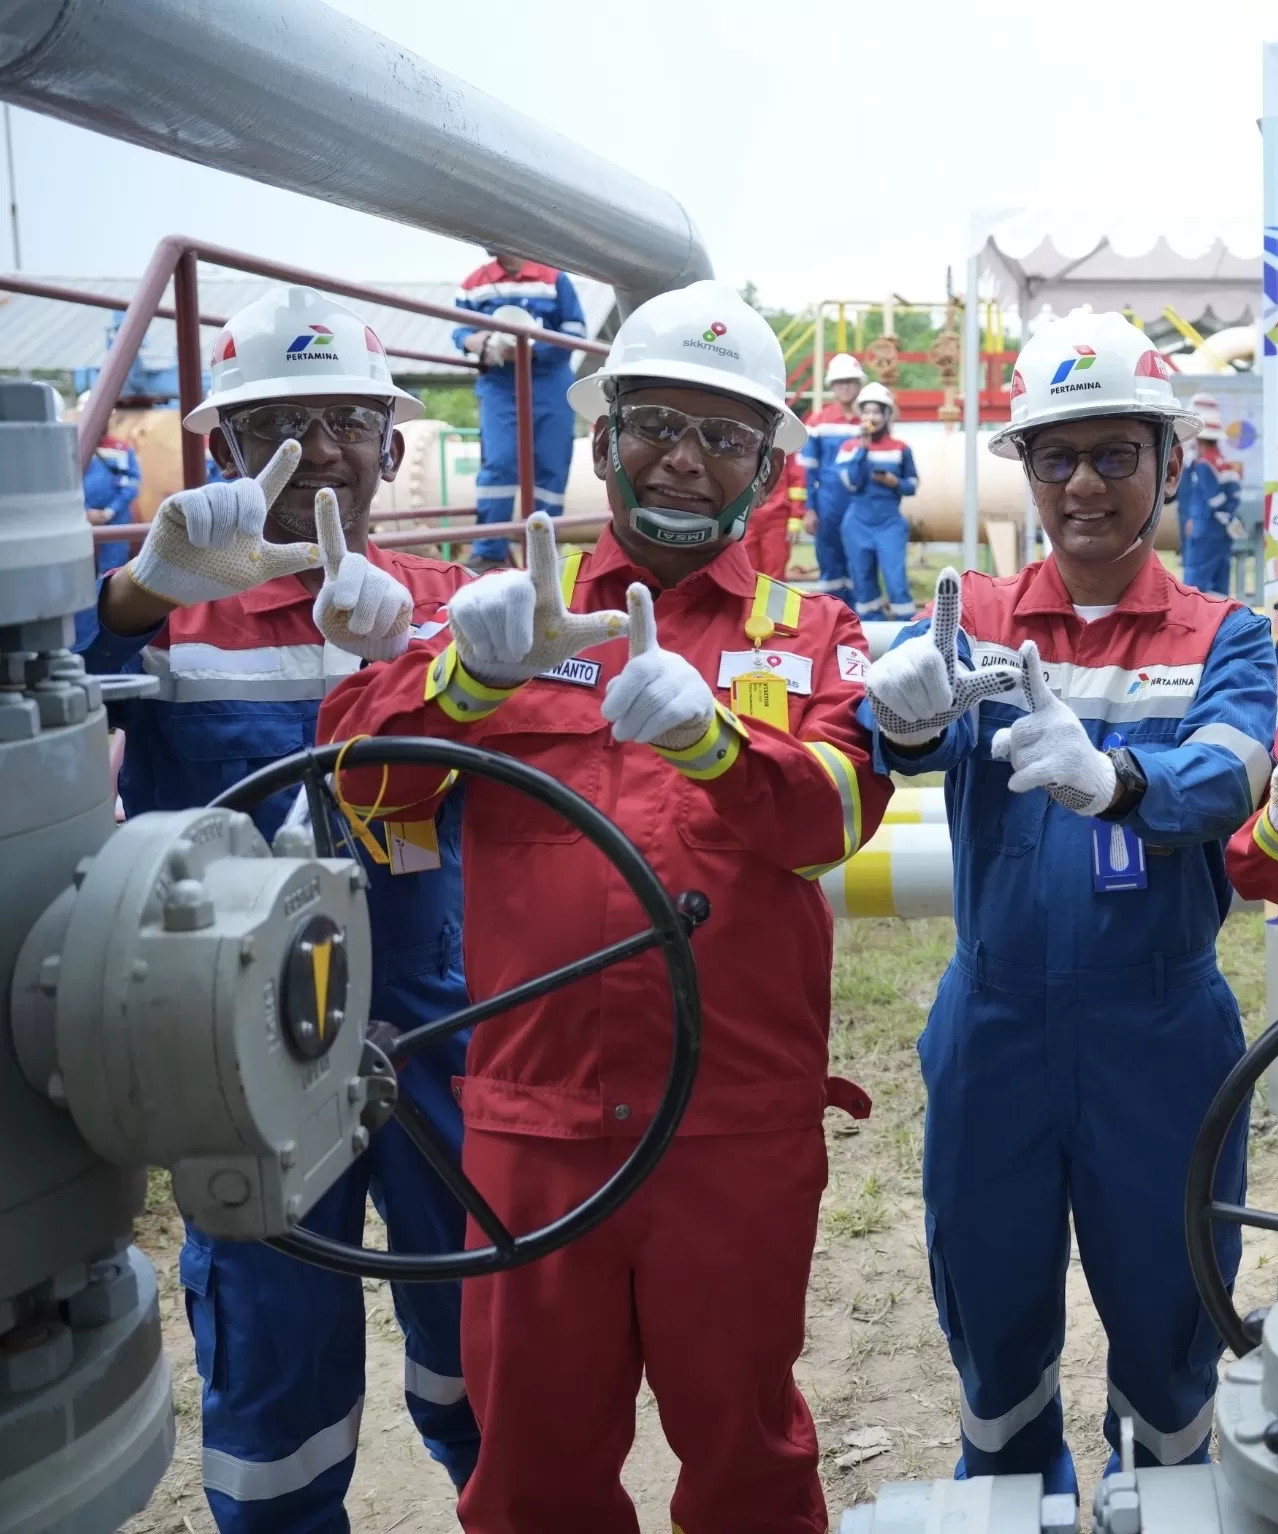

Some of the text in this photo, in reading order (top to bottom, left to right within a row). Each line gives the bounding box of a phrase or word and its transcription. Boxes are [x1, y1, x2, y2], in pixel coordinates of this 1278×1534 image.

[682, 338, 740, 360] skkmigas
[286, 352, 339, 361] PERTAMINA
[1050, 381, 1102, 395] PERTAMINA
